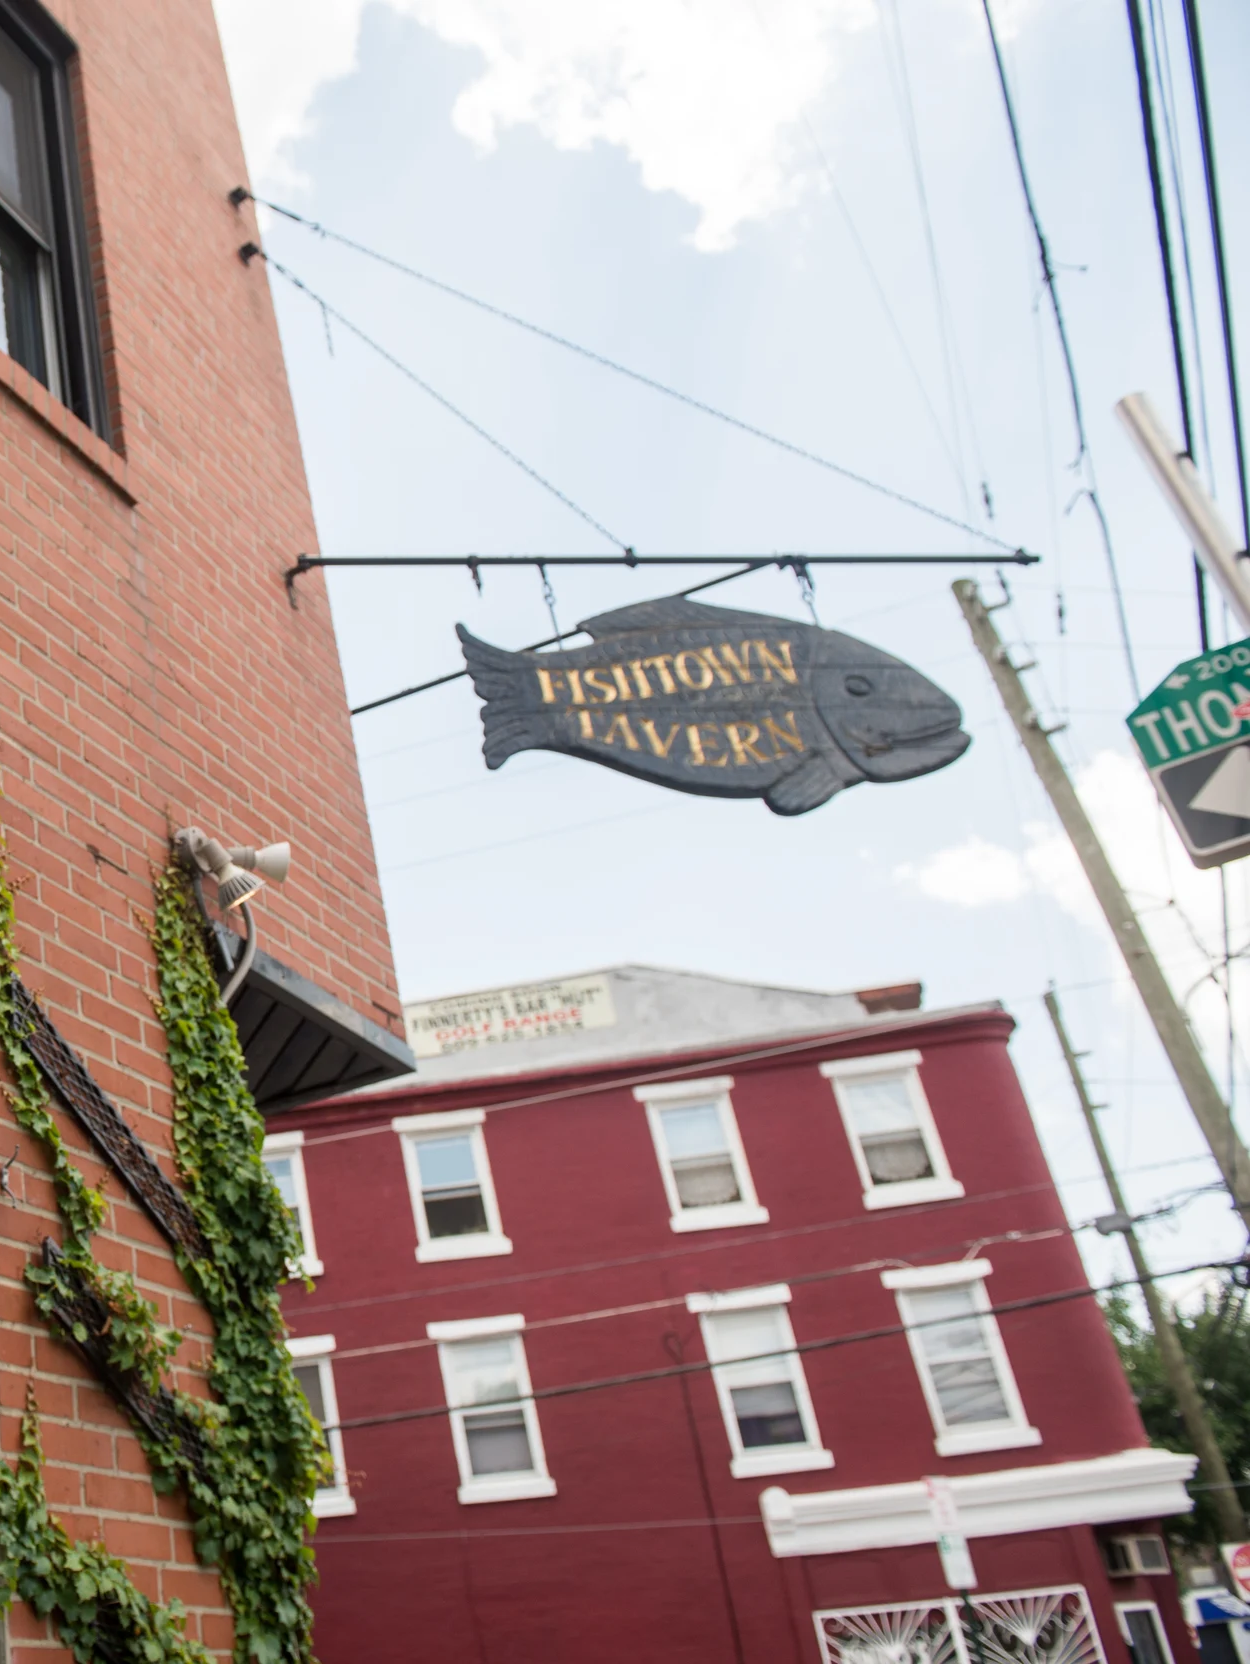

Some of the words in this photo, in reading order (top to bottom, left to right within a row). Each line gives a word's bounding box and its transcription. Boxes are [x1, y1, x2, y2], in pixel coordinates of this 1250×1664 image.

[536, 640, 798, 705] FISHTOWN
[1193, 647, 1250, 681] 200
[566, 708, 807, 767] TAVERN
[514, 996, 546, 1015] BAR
[435, 1023, 492, 1042] GOLF
[502, 1008, 582, 1031] RANGE
